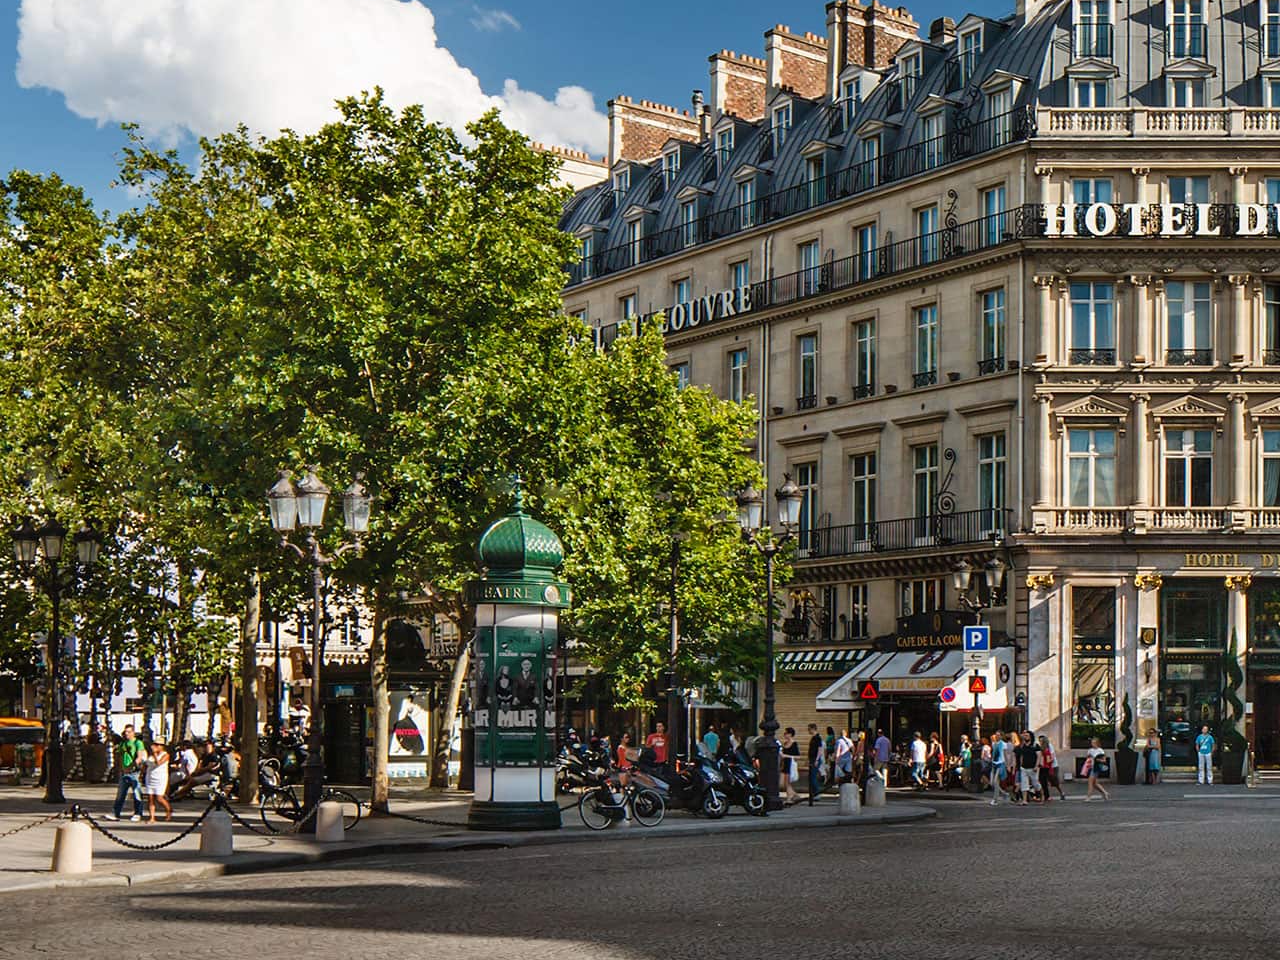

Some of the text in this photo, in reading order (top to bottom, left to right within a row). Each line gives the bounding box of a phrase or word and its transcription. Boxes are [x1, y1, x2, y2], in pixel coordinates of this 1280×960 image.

[1043, 202, 1221, 237] HOTEL
[1184, 553, 1245, 568] HOTEL
[929, 634, 942, 646] LA
[943, 634, 963, 646] COM
[970, 631, 983, 648] P
[497, 709, 538, 728] MUR
